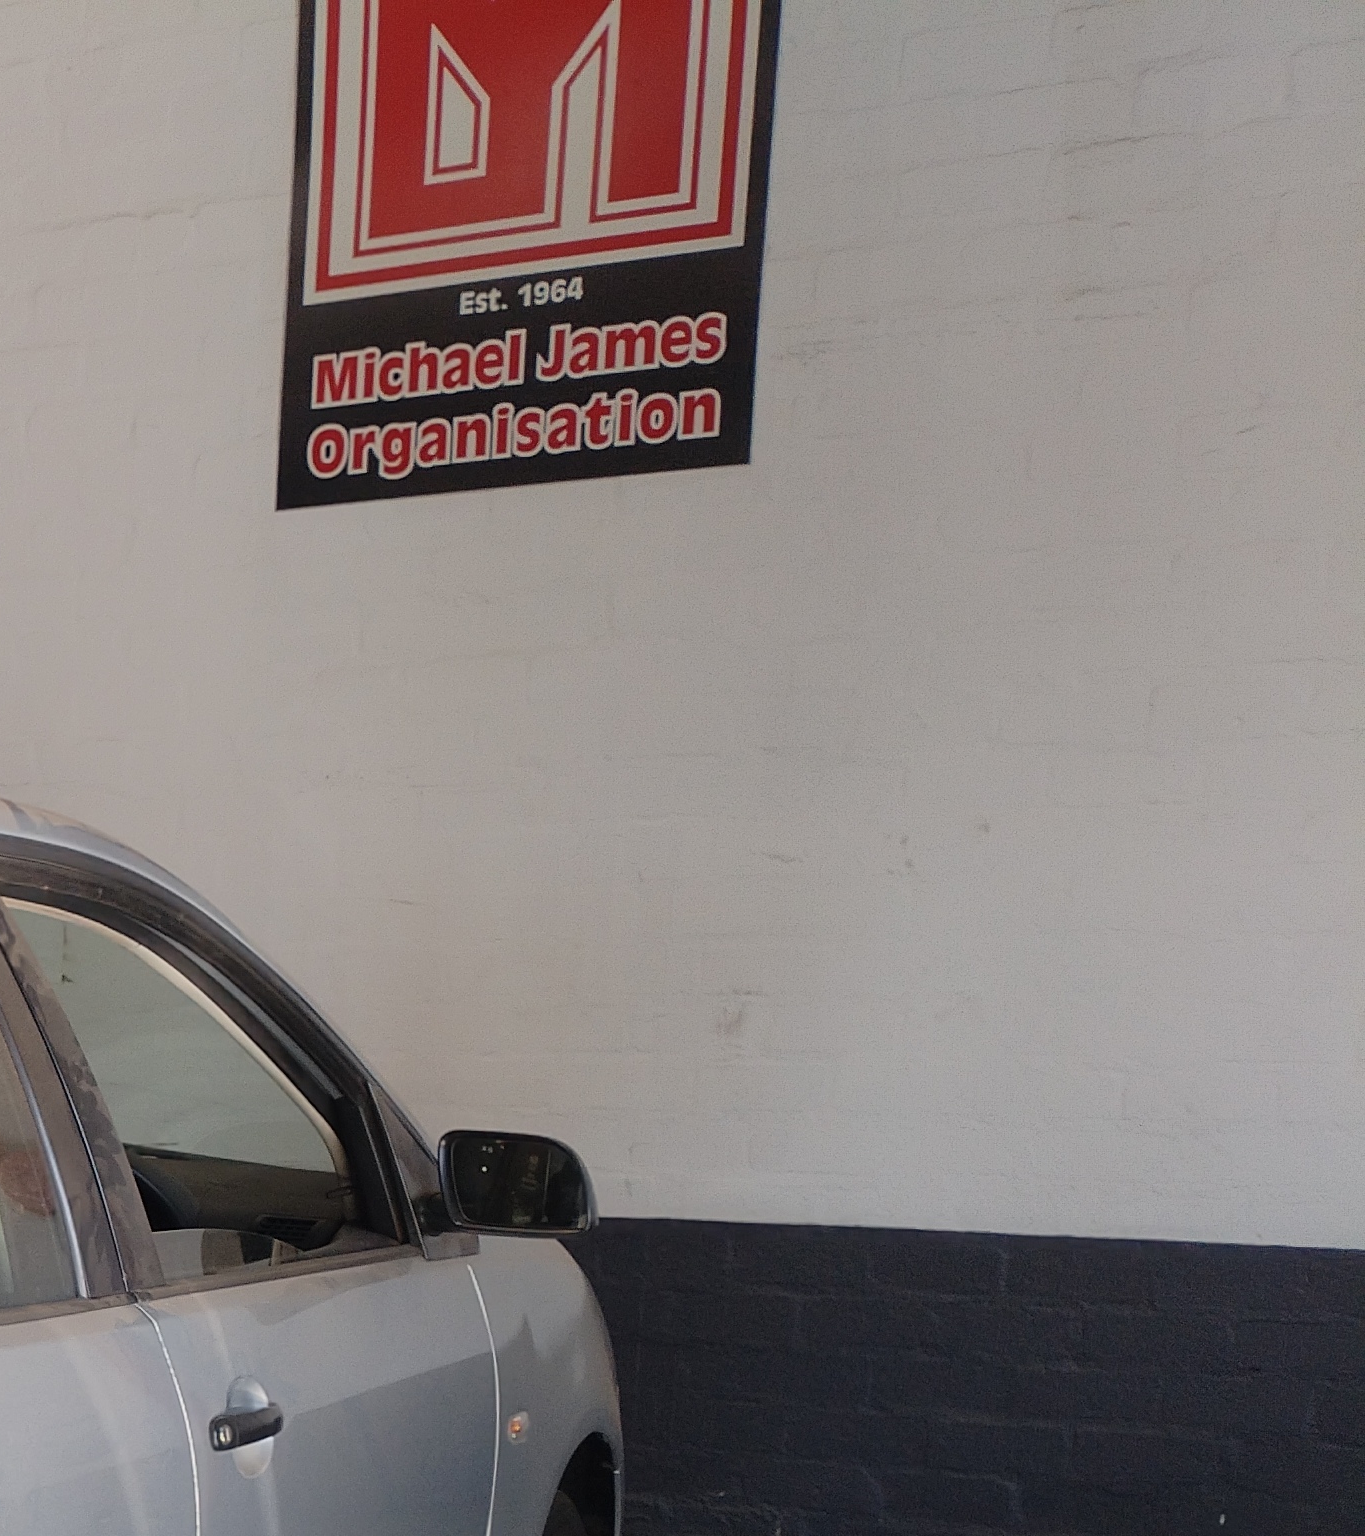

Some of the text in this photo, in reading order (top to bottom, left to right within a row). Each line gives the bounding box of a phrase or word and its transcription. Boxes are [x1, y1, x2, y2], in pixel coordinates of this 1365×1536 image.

[459, 276, 584, 315] Est. 1964
[311, 313, 727, 410] Michael James
[307, 388, 721, 479] Organisation
